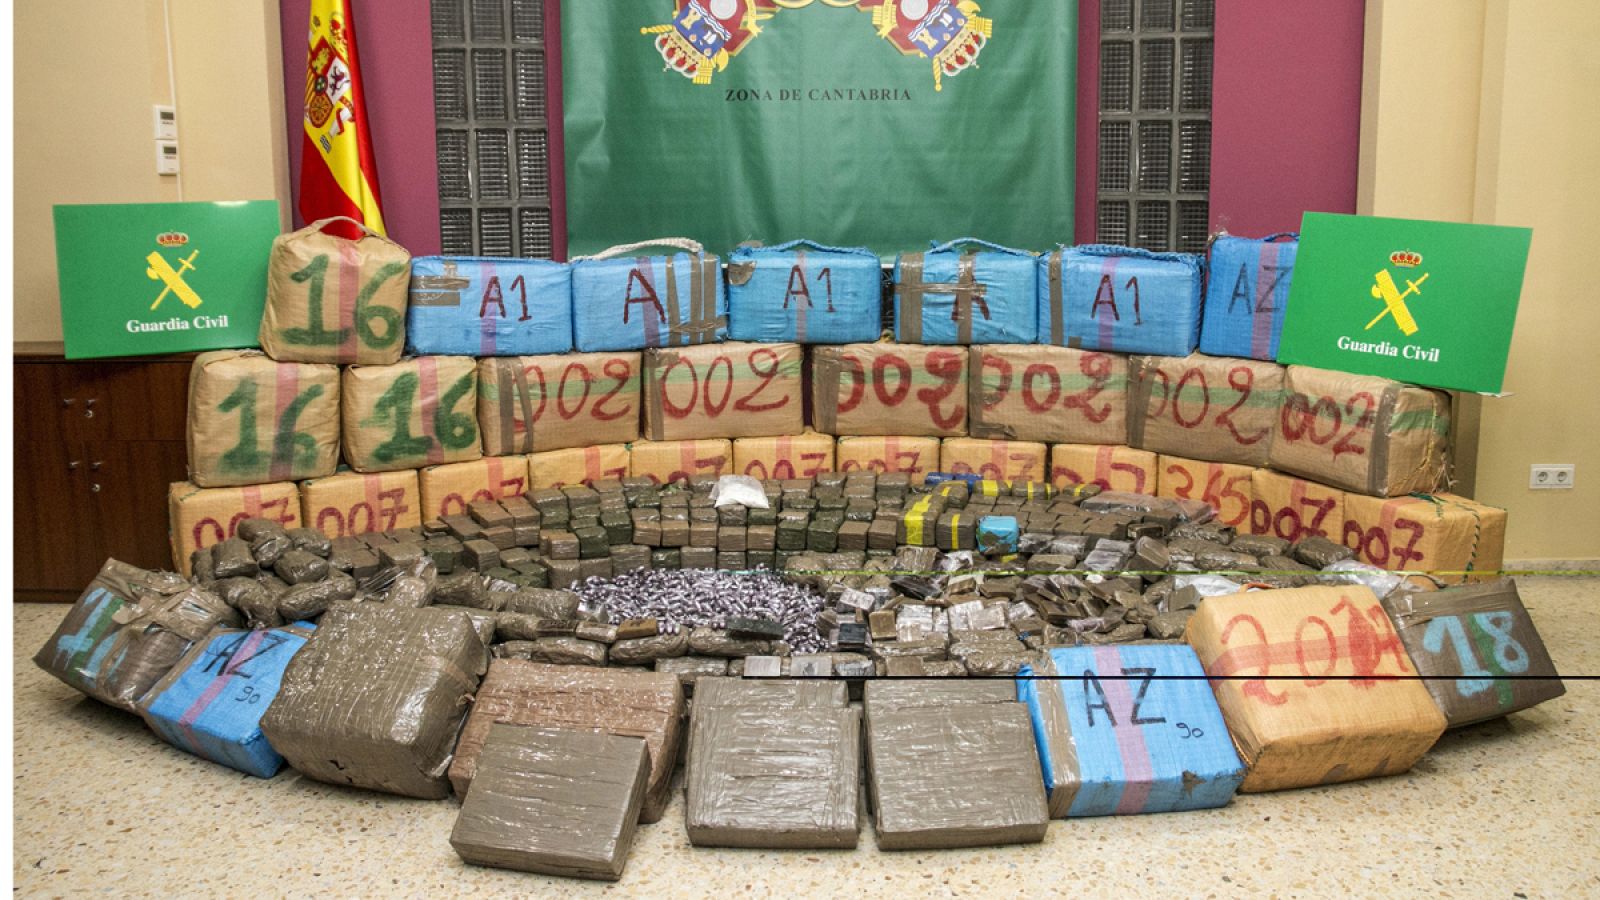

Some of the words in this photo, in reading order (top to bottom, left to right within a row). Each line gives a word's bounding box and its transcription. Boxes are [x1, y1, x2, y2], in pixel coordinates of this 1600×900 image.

[725, 88, 773, 102] ZONA
[779, 88, 801, 102] DE
[808, 88, 912, 102] CANTABRIA
[279, 253, 409, 350] 16
[479, 274, 532, 323] A1
[784, 264, 837, 313] A1
[1091, 273, 1144, 326] A1
[126, 317, 189, 334] Guardia
[193, 314, 229, 330] Civil
[1336, 335, 1399, 358] Guardia
[1402, 343, 1440, 363] Civil
[661, 347, 790, 419] 002
[214, 376, 326, 478] 16
[364, 369, 478, 462] 16
[1281, 391, 1376, 456] 002
[317, 486, 409, 537] 007
[1251, 496, 1336, 543] 007
[1343, 518, 1425, 571] 007
[202, 629, 289, 679] AZ
[1423, 610, 1529, 697] 18
[1081, 667, 1167, 728] AZ
